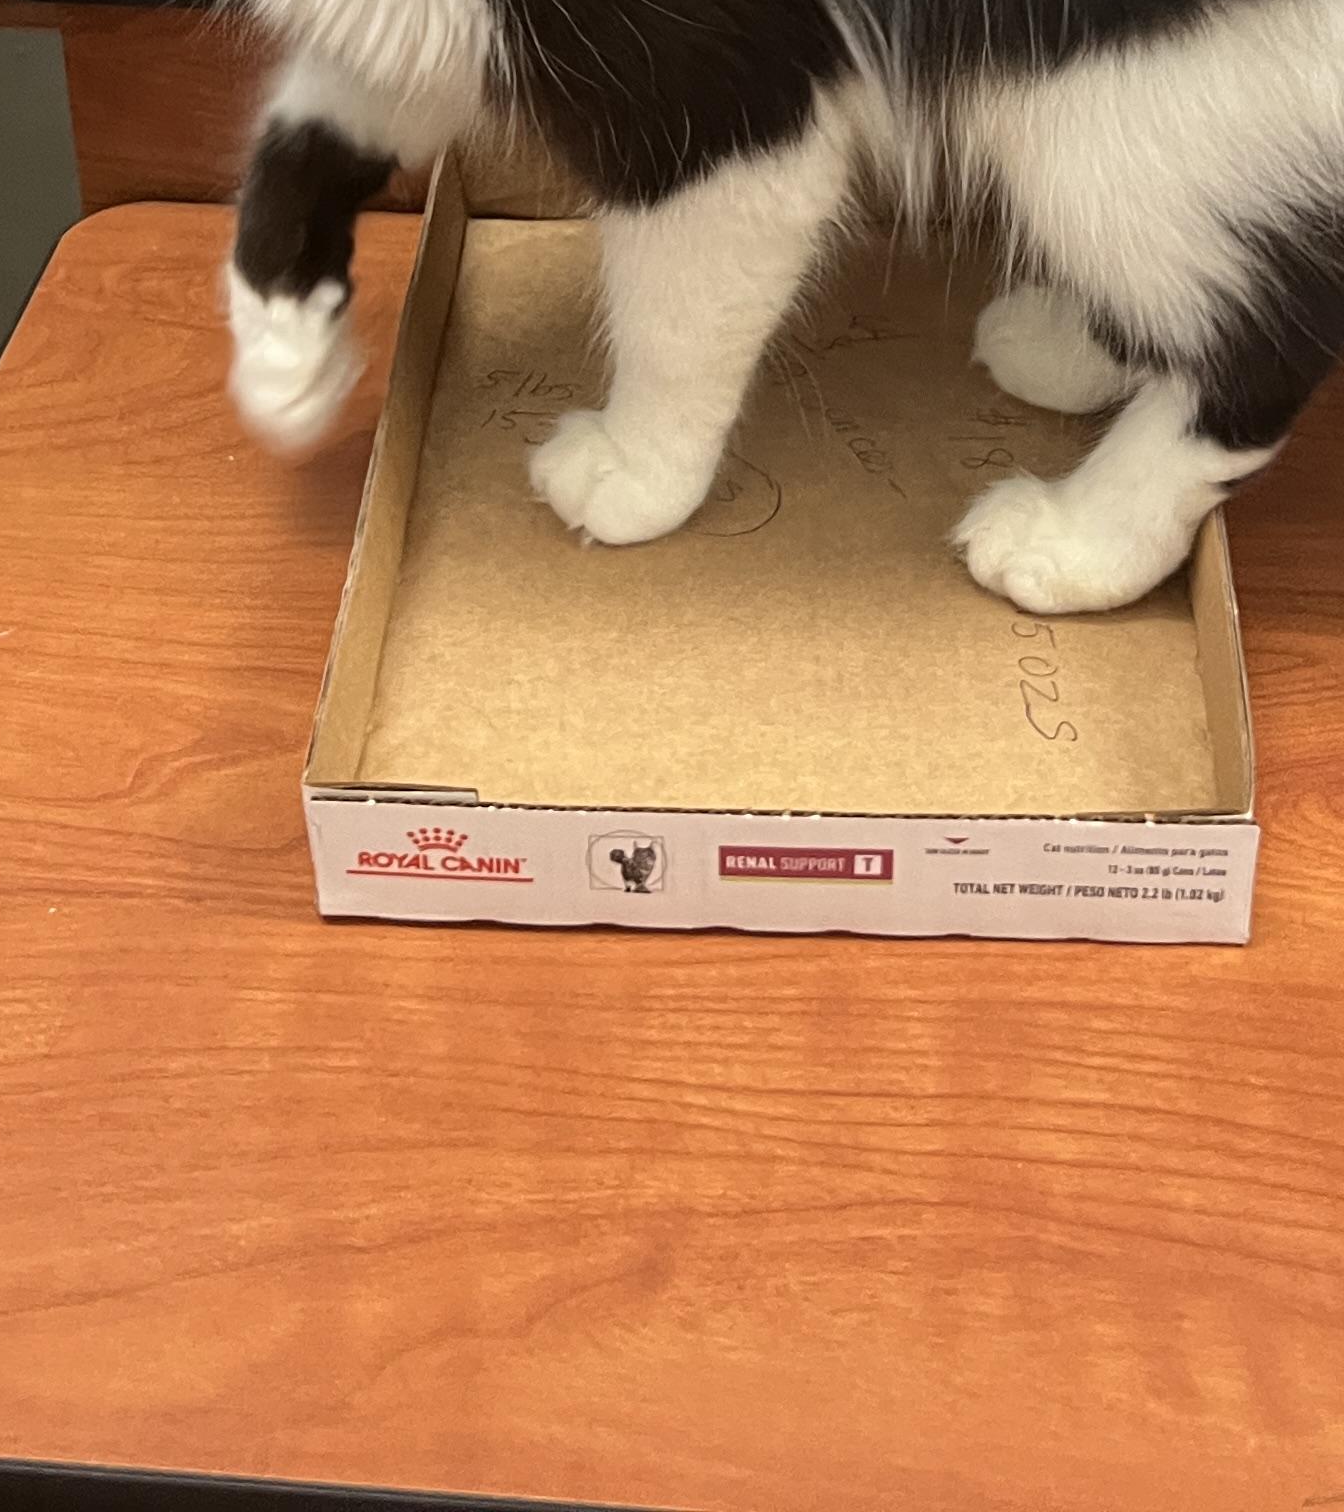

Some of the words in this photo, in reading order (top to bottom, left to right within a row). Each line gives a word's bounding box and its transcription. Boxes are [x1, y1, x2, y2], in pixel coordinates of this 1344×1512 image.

[358, 851, 435, 871] ROYAL
[440, 855, 521, 874] CANIN
[725, 854, 777, 871] RENAL
[780, 856, 846, 872] SUPPORT
[862, 857, 874, 872] T
[953, 882, 991, 894] TOTAL
[992, 883, 1016, 895] NET
[1018, 884, 1064, 896] WEIGHT
[1073, 885, 1105, 898] PESO
[1107, 887, 1139, 899] NETO
[1141, 888, 1159, 899] 2.2
[1161, 888, 1172, 900] lb
[1175, 888, 1204, 900] (1.02
[1206, 889, 1225, 903] kg)
